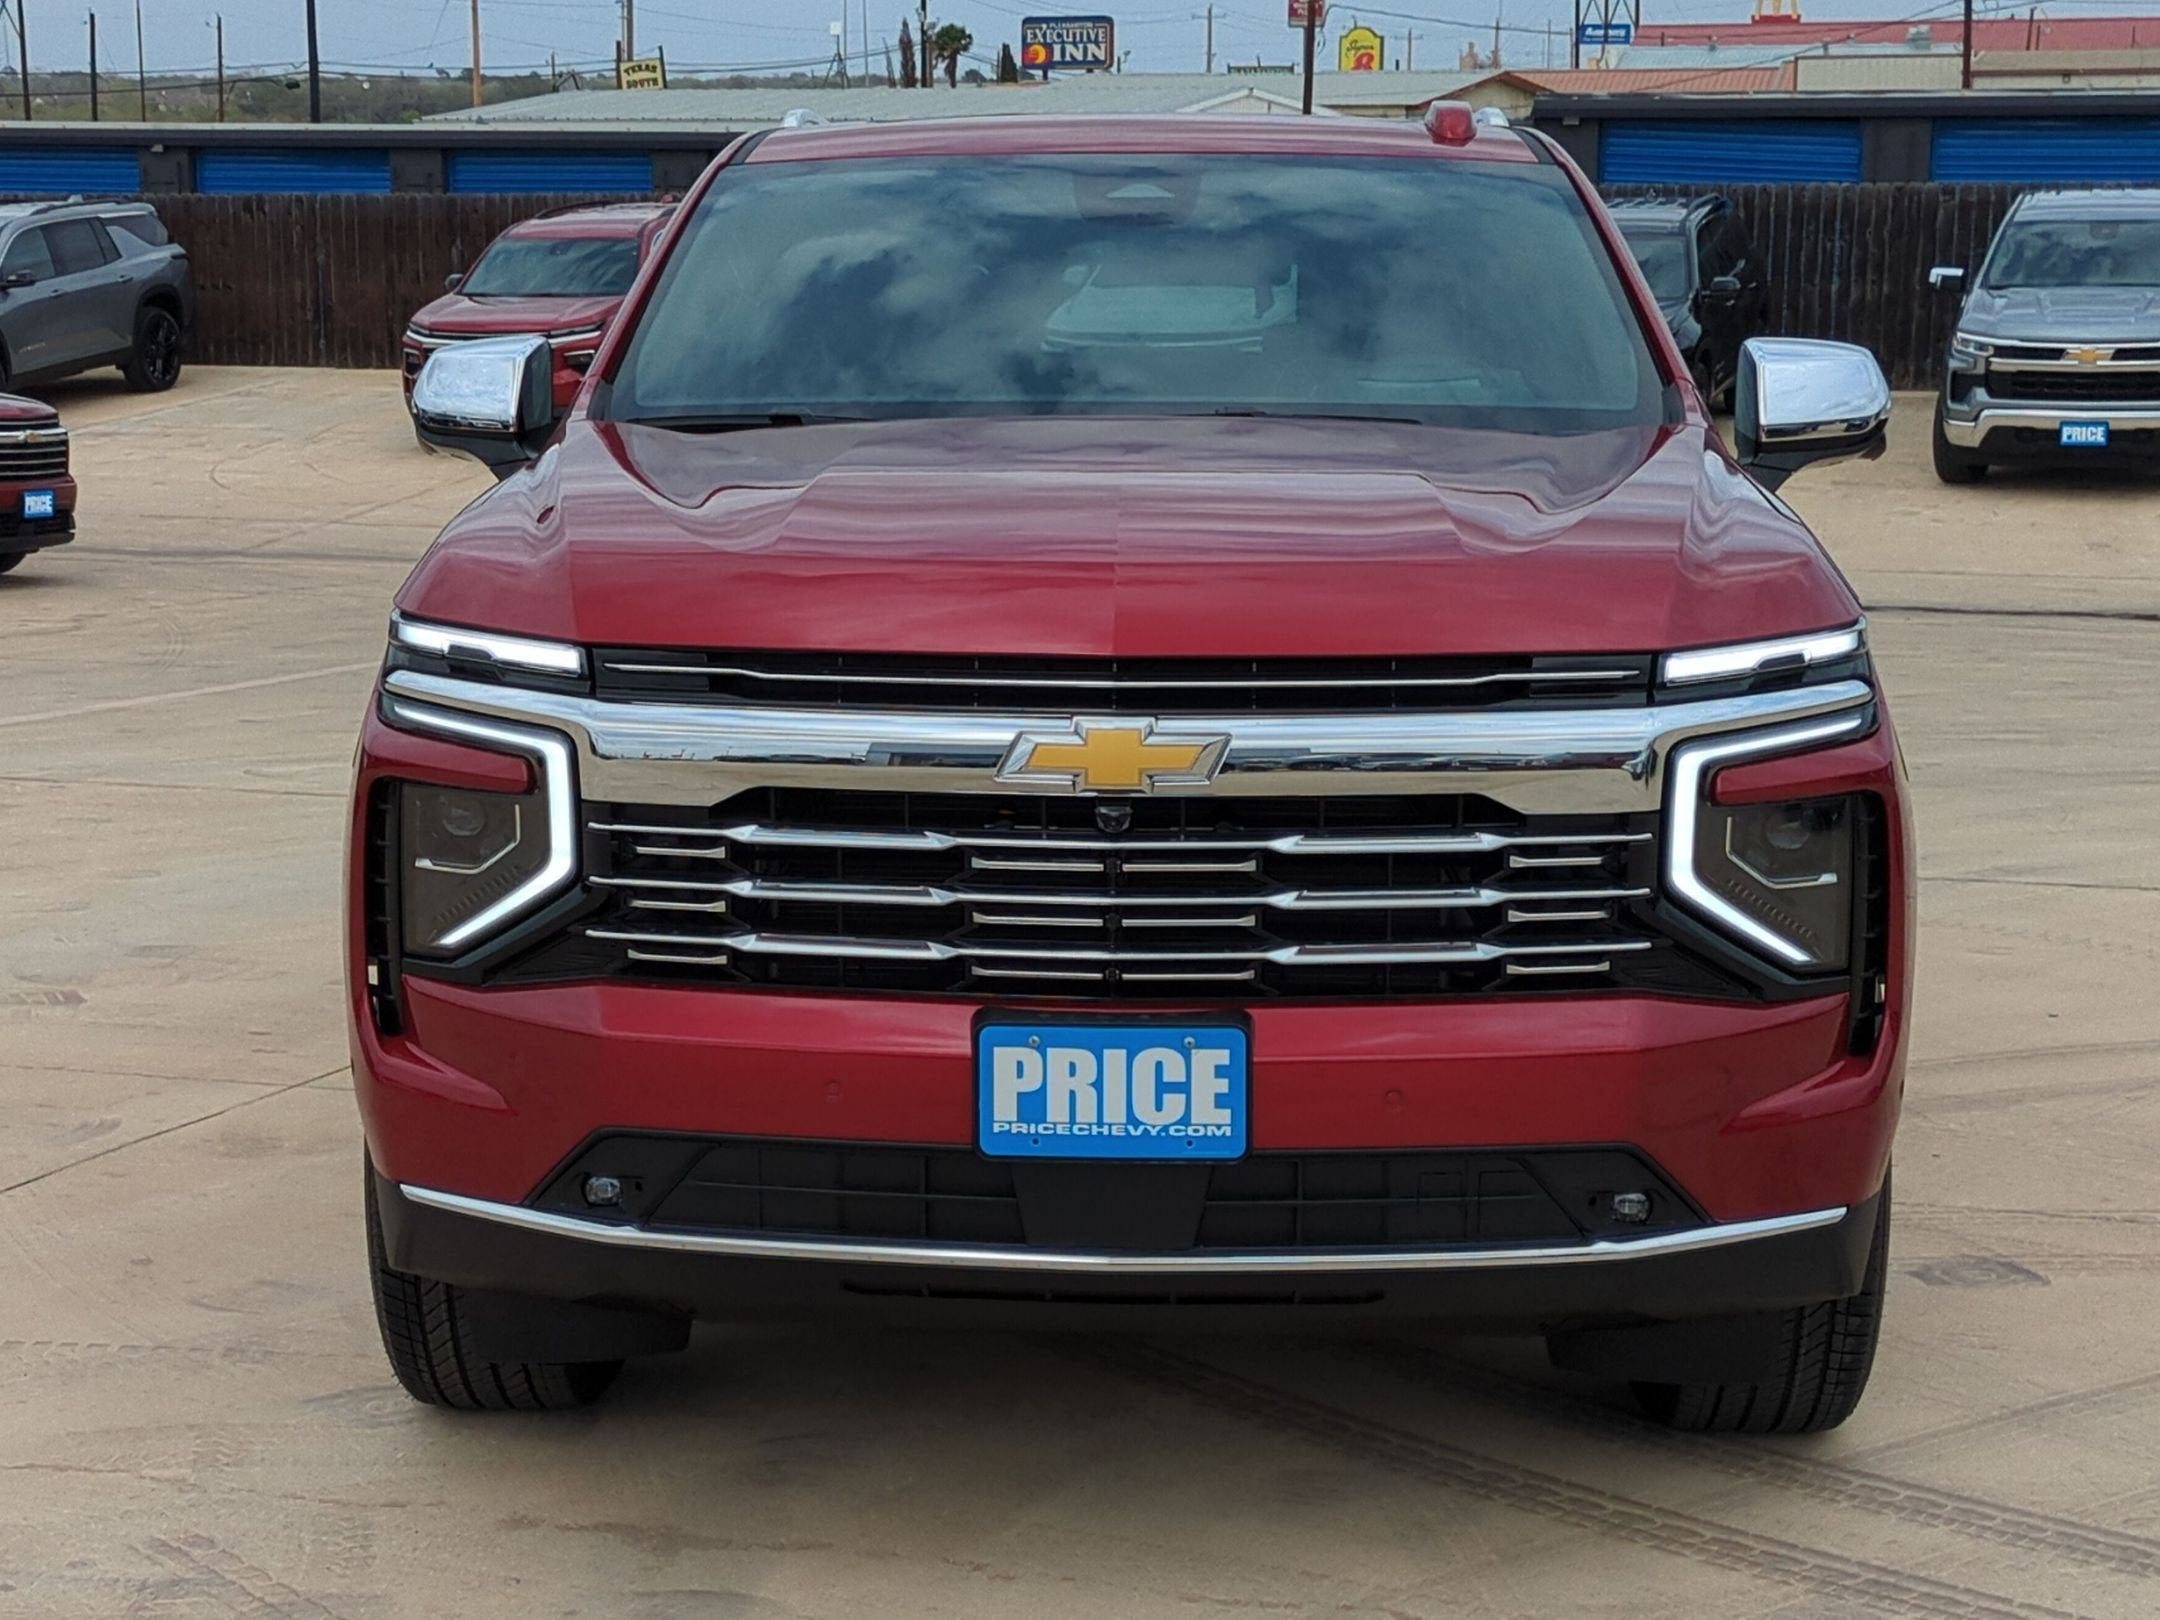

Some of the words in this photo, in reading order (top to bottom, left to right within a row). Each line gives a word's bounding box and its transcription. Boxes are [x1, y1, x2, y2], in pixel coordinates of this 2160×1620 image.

[1026, 24, 1106, 43] EXECUTIVE
[1053, 43, 1106, 62] INN
[623, 63, 658, 76] TEXAS
[626, 77, 659, 89] SOUTH
[2062, 426, 2105, 443] PRICE
[992, 1046, 1232, 1125] PRICE
[992, 1122, 1232, 1137] PRICECHEVY.COM
